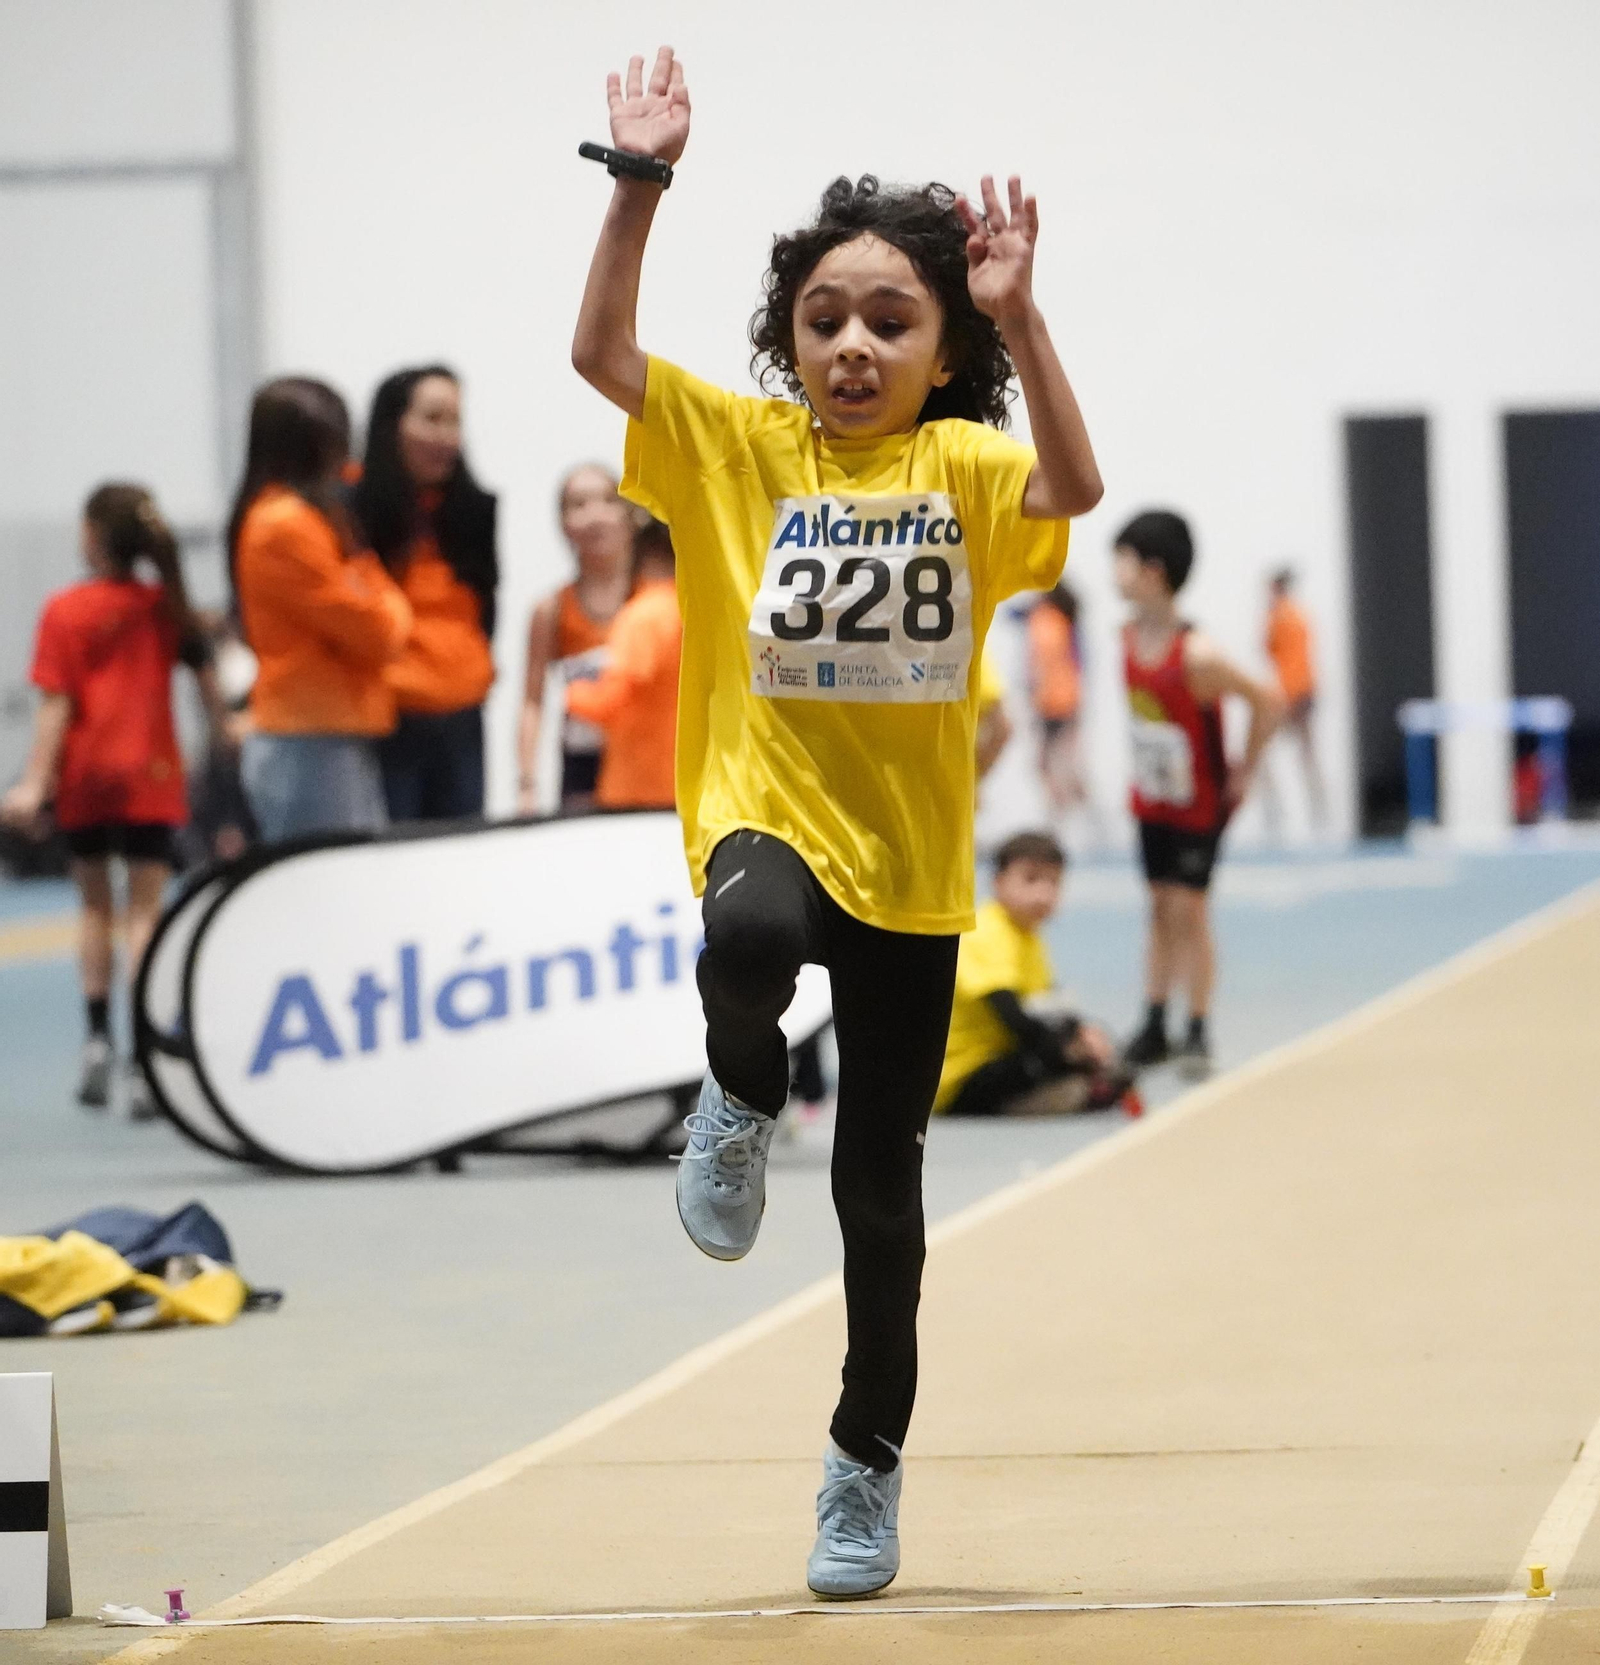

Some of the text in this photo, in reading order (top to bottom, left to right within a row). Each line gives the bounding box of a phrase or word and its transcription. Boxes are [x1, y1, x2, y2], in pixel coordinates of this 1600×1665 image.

[774, 503, 963, 549] Atlántico
[770, 556, 954, 642] 328
[838, 676, 904, 688] DE GALICIA
[839, 664, 878, 675] XUNTA
